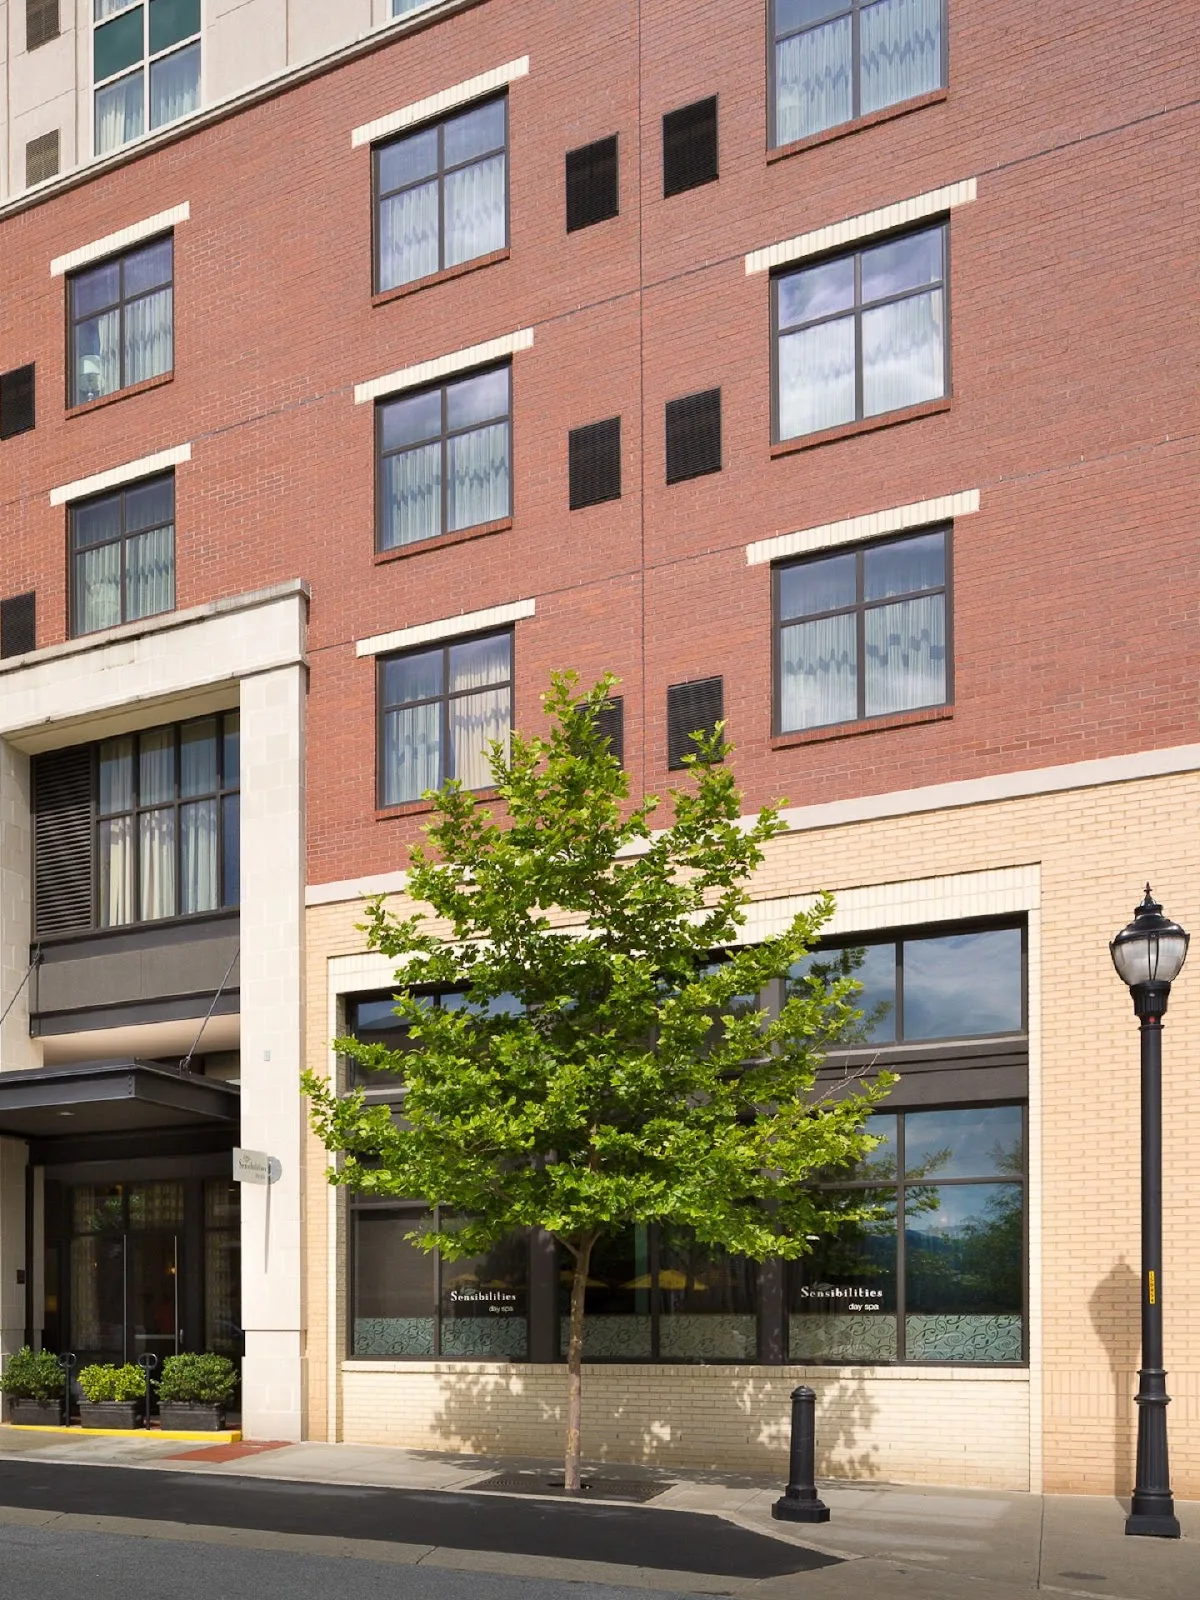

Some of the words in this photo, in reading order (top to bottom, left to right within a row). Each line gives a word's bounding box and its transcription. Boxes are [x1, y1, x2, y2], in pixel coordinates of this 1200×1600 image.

[450, 1290, 517, 1302] Sensibilities
[800, 1286, 883, 1298] Sensibilities
[848, 1303, 863, 1312] day
[864, 1303, 880, 1312] spa
